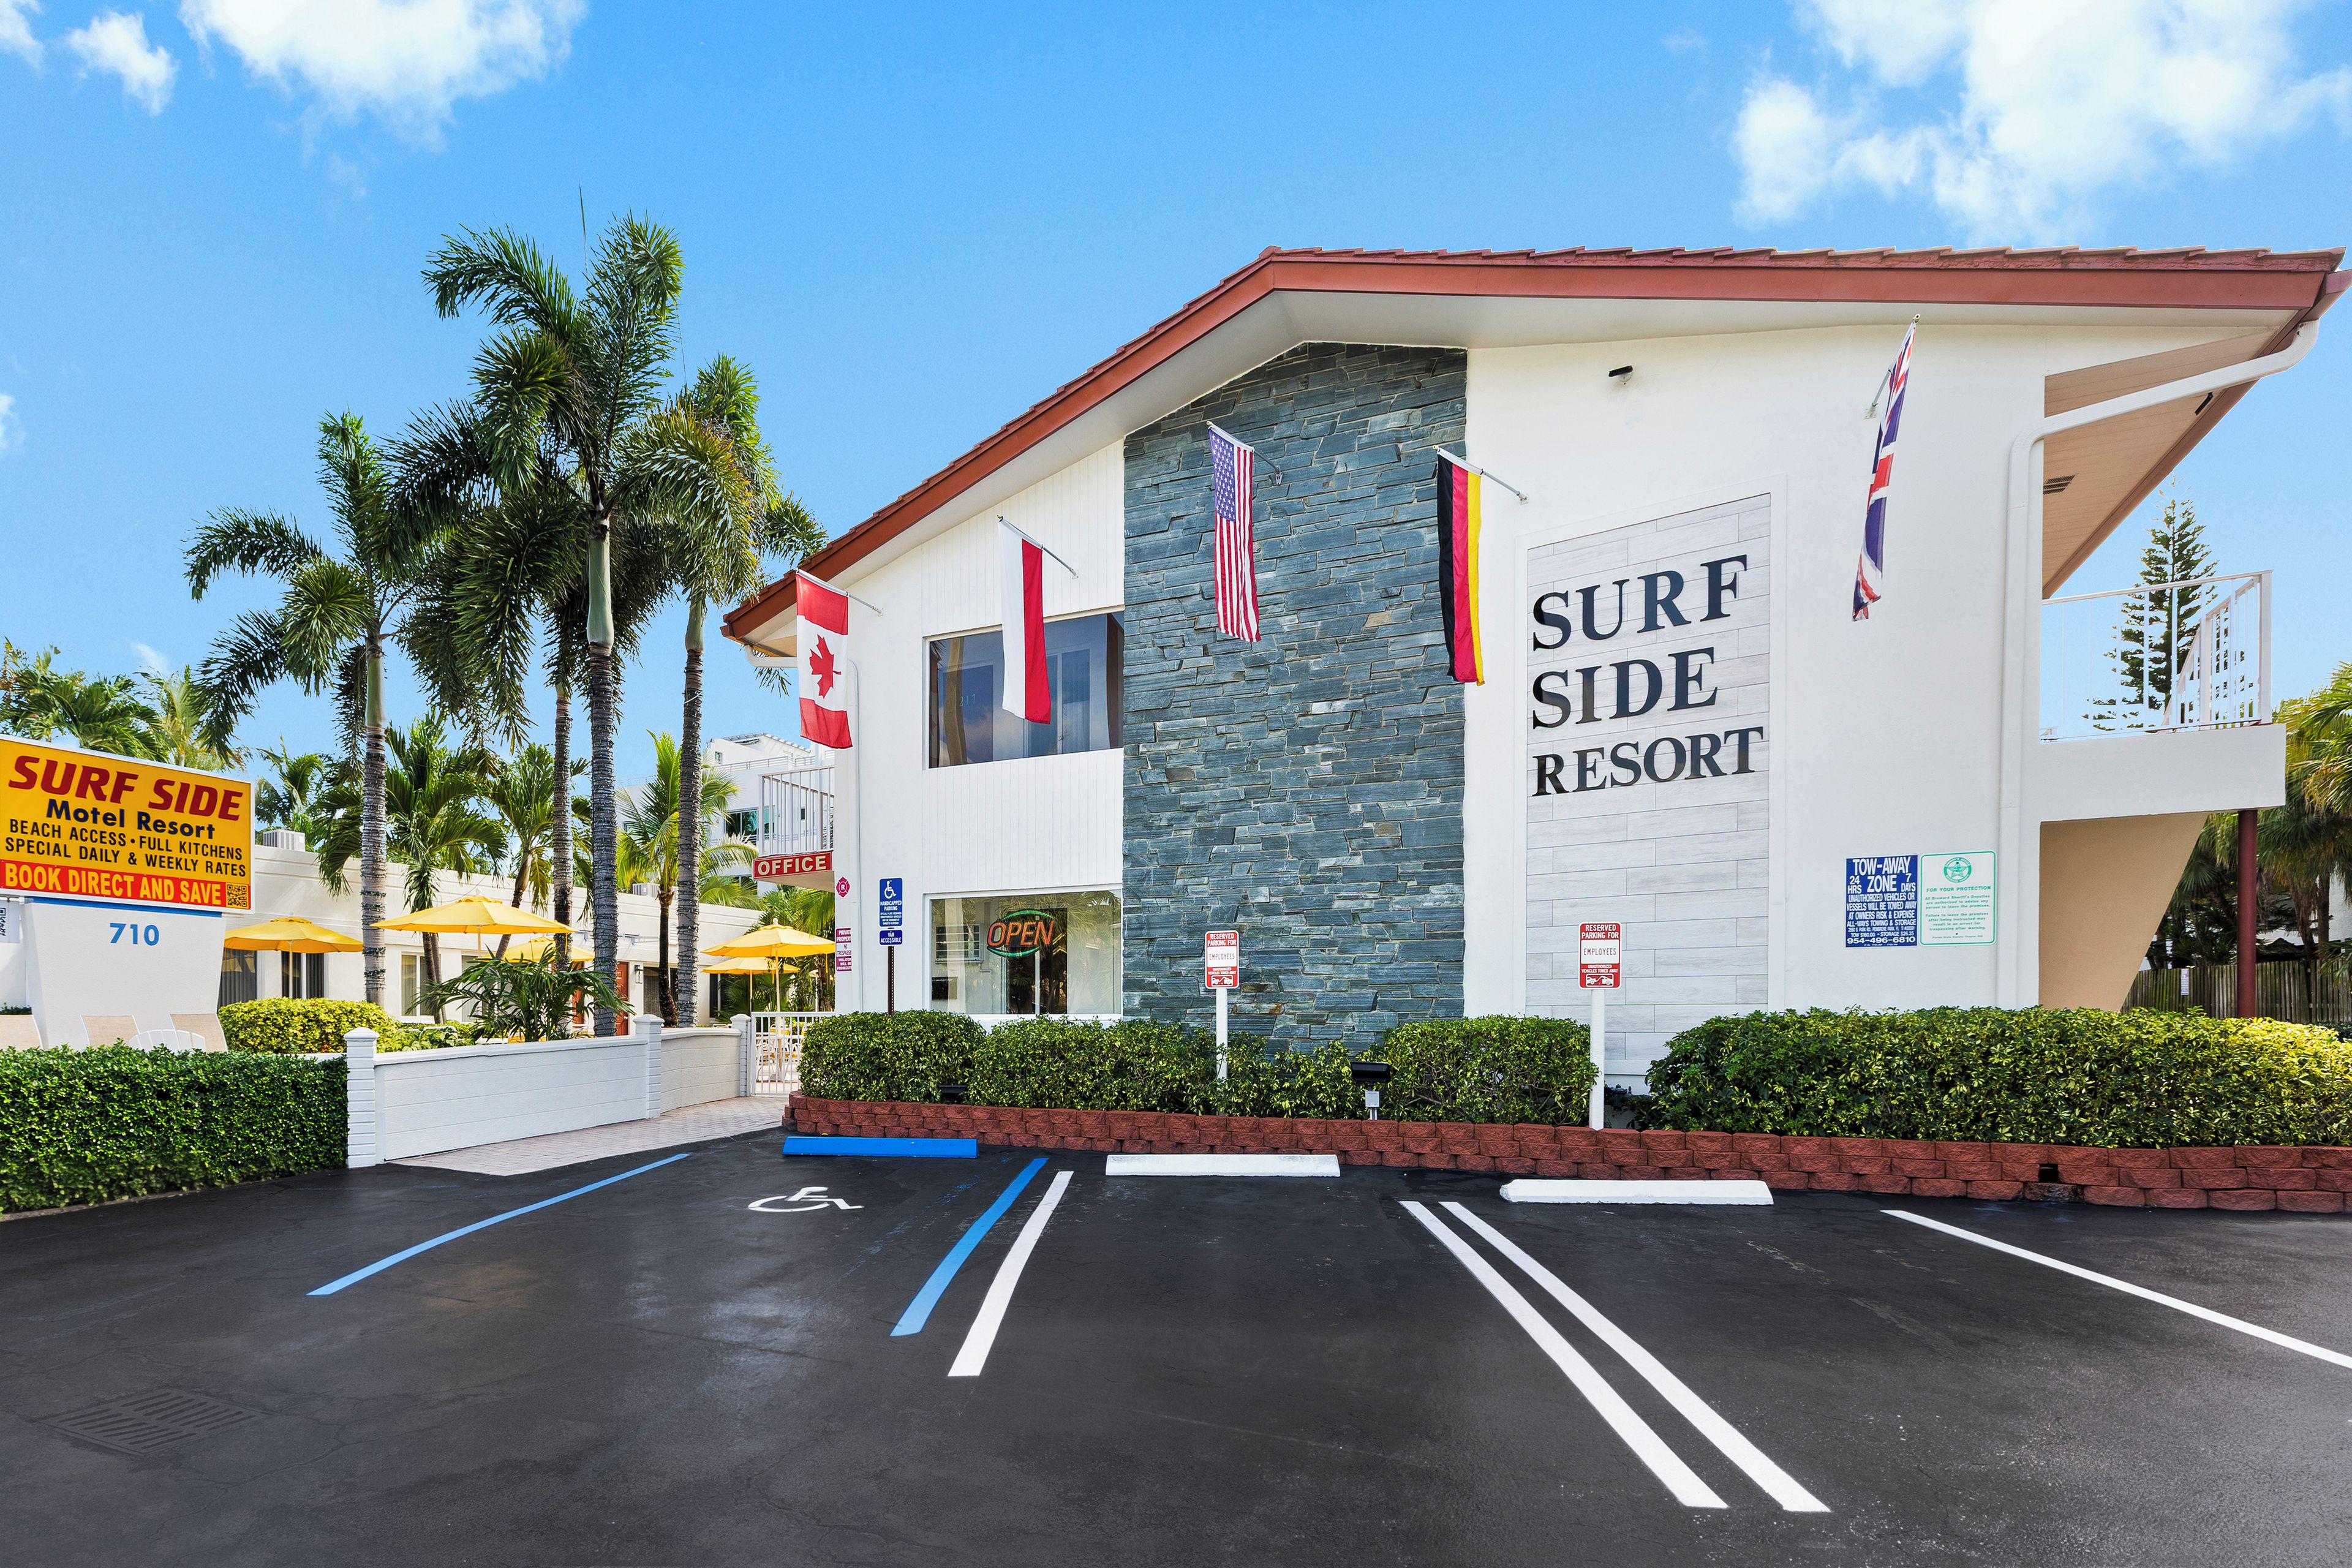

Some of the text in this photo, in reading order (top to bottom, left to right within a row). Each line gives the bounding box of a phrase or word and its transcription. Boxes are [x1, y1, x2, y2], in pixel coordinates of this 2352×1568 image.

[1532, 554, 1747, 652] SURF
[1532, 647, 1718, 730] SIDE
[1532, 726, 1763, 797] RESORT
[9, 755, 244, 821] SURF SIDE
[47, 799, 215, 839] Motel Resort
[10, 819, 242, 861] BEACH ACCESS FULL KITCHENS
[5, 837, 246, 877] SPECIAL DAILY & WEEKLY RATES
[758, 855, 826, 876] OFFICE
[1852, 856, 1911, 876] TOW-AWAY
[5, 862, 221, 905] BOOK DIRECT AND SAVE
[1850, 875, 1860, 884] 24
[1867, 875, 1897, 892] ZONE
[1901, 882, 1916, 892] DAYS
[1905, 873, 1912, 882] 7
[1847, 885, 1862, 894] HRS
[1849, 894, 1883, 902] UNAUTHORIZED
[1884, 892, 1906, 901] VEHICLES
[1846, 903, 1867, 911] VESSELS
[1868, 902, 1879, 911] WILL
[1887, 902, 1904, 910] TOWED
[1905, 901, 1917, 909] AWAY
[1855, 911, 1875, 920] OWNERS
[1876, 911, 1887, 919] RISK
[1894, 910, 1915, 919] EXPENSE
[110, 922, 160, 946] 710
[987, 920, 1055, 947] OPEN
